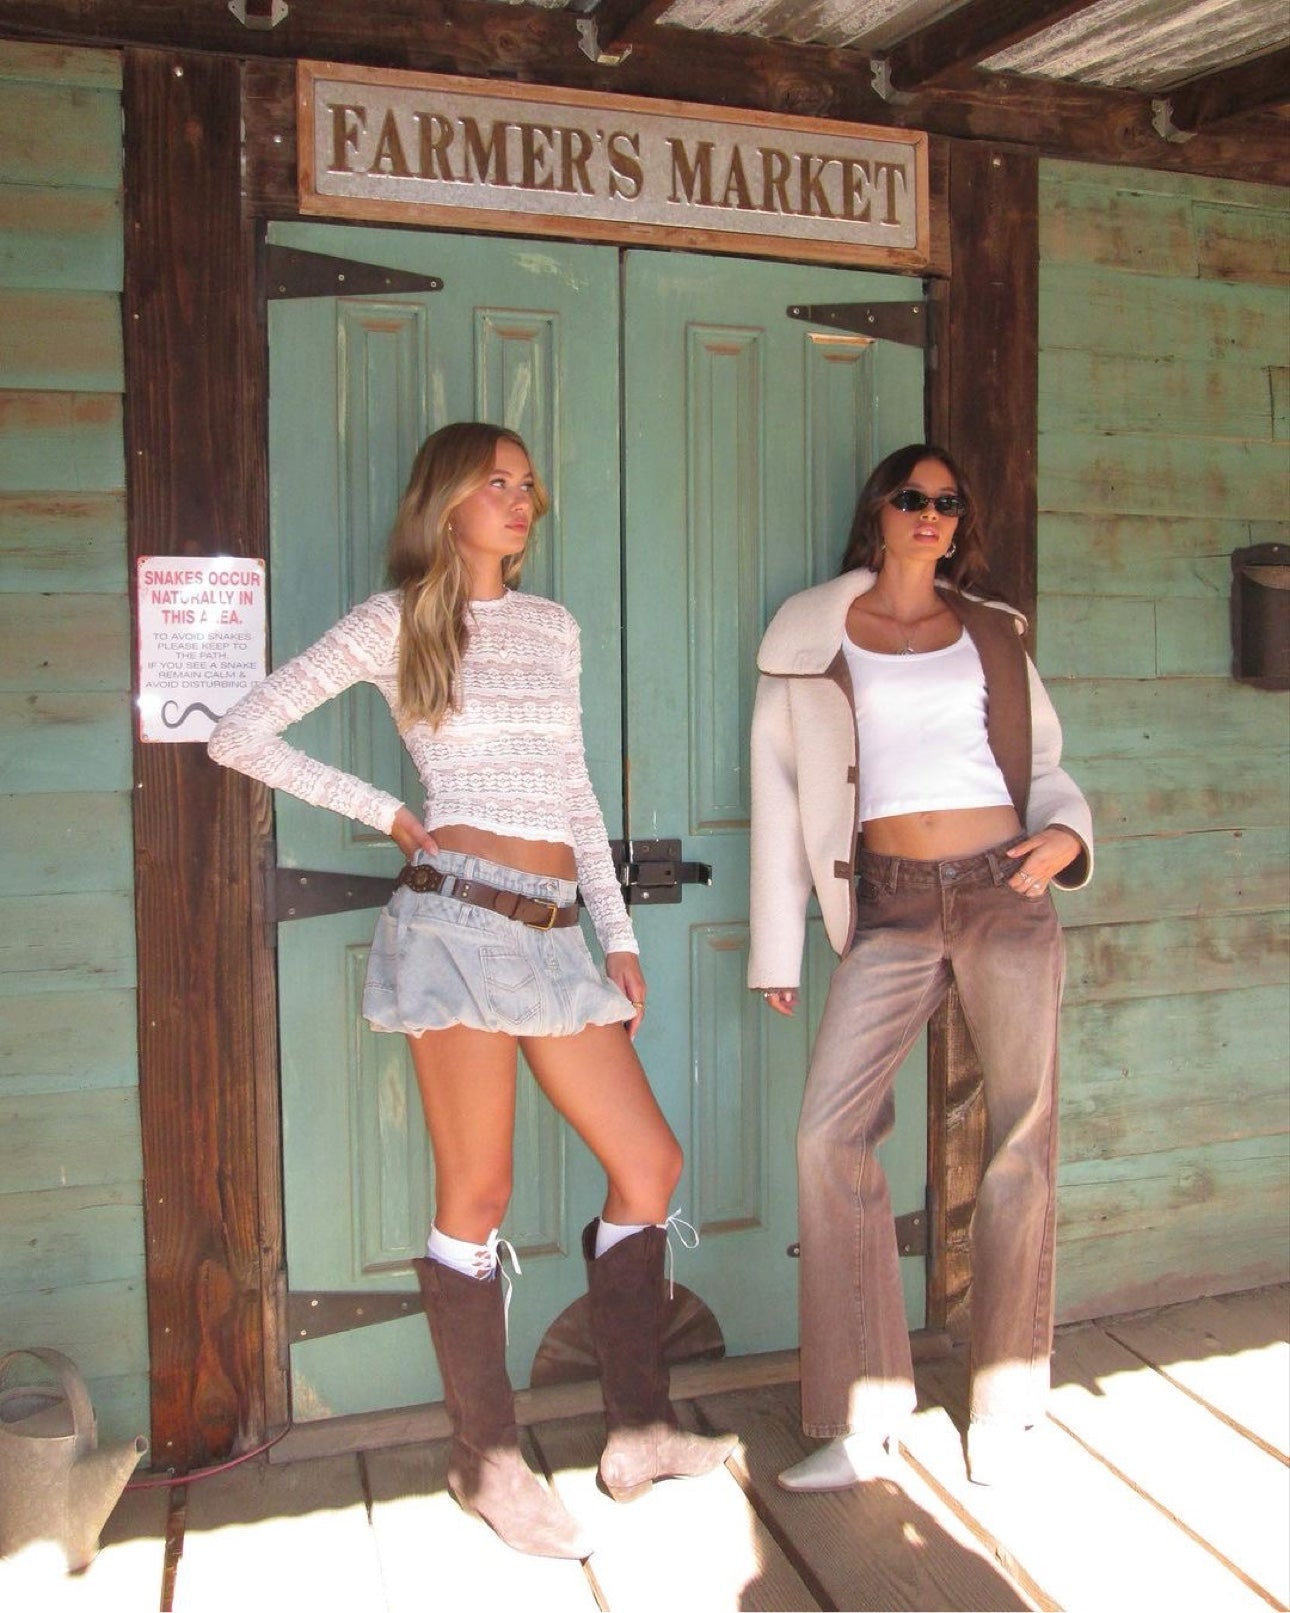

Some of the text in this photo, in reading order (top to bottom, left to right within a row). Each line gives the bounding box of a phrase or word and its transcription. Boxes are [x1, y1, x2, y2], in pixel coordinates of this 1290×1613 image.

[328, 102, 908, 226] FARMER'S MARKET
[144, 570, 261, 586] SNAKES OCCUR
[239, 591, 254, 605] IN
[162, 610, 243, 625] THIS AEA.
[157, 642, 199, 650] PLEASE
[220, 662, 257, 670] SNAKE
[158, 671, 202, 679] REMAIN
[204, 671, 236, 679] CALM
